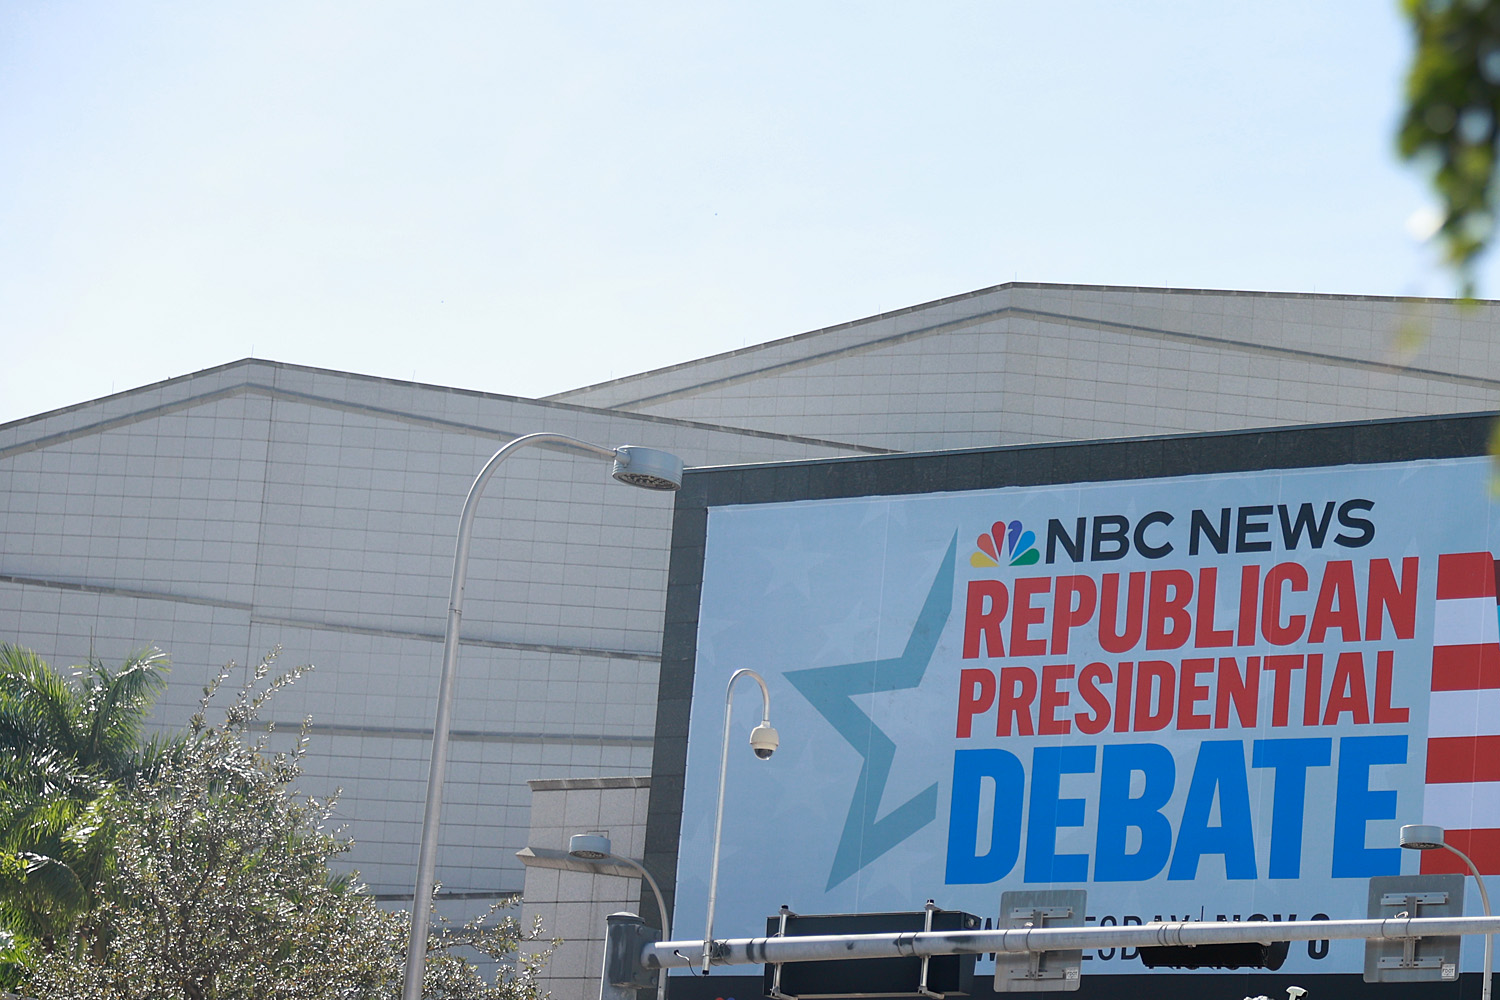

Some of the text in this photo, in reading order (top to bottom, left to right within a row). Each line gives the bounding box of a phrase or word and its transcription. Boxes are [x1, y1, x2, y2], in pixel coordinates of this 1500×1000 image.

[1045, 498, 1375, 564] NBC NEWS
[962, 556, 1420, 659] REPUBLICAN
[955, 650, 1410, 738] PRESIDENTIAL
[944, 735, 1409, 885] DEBATE
